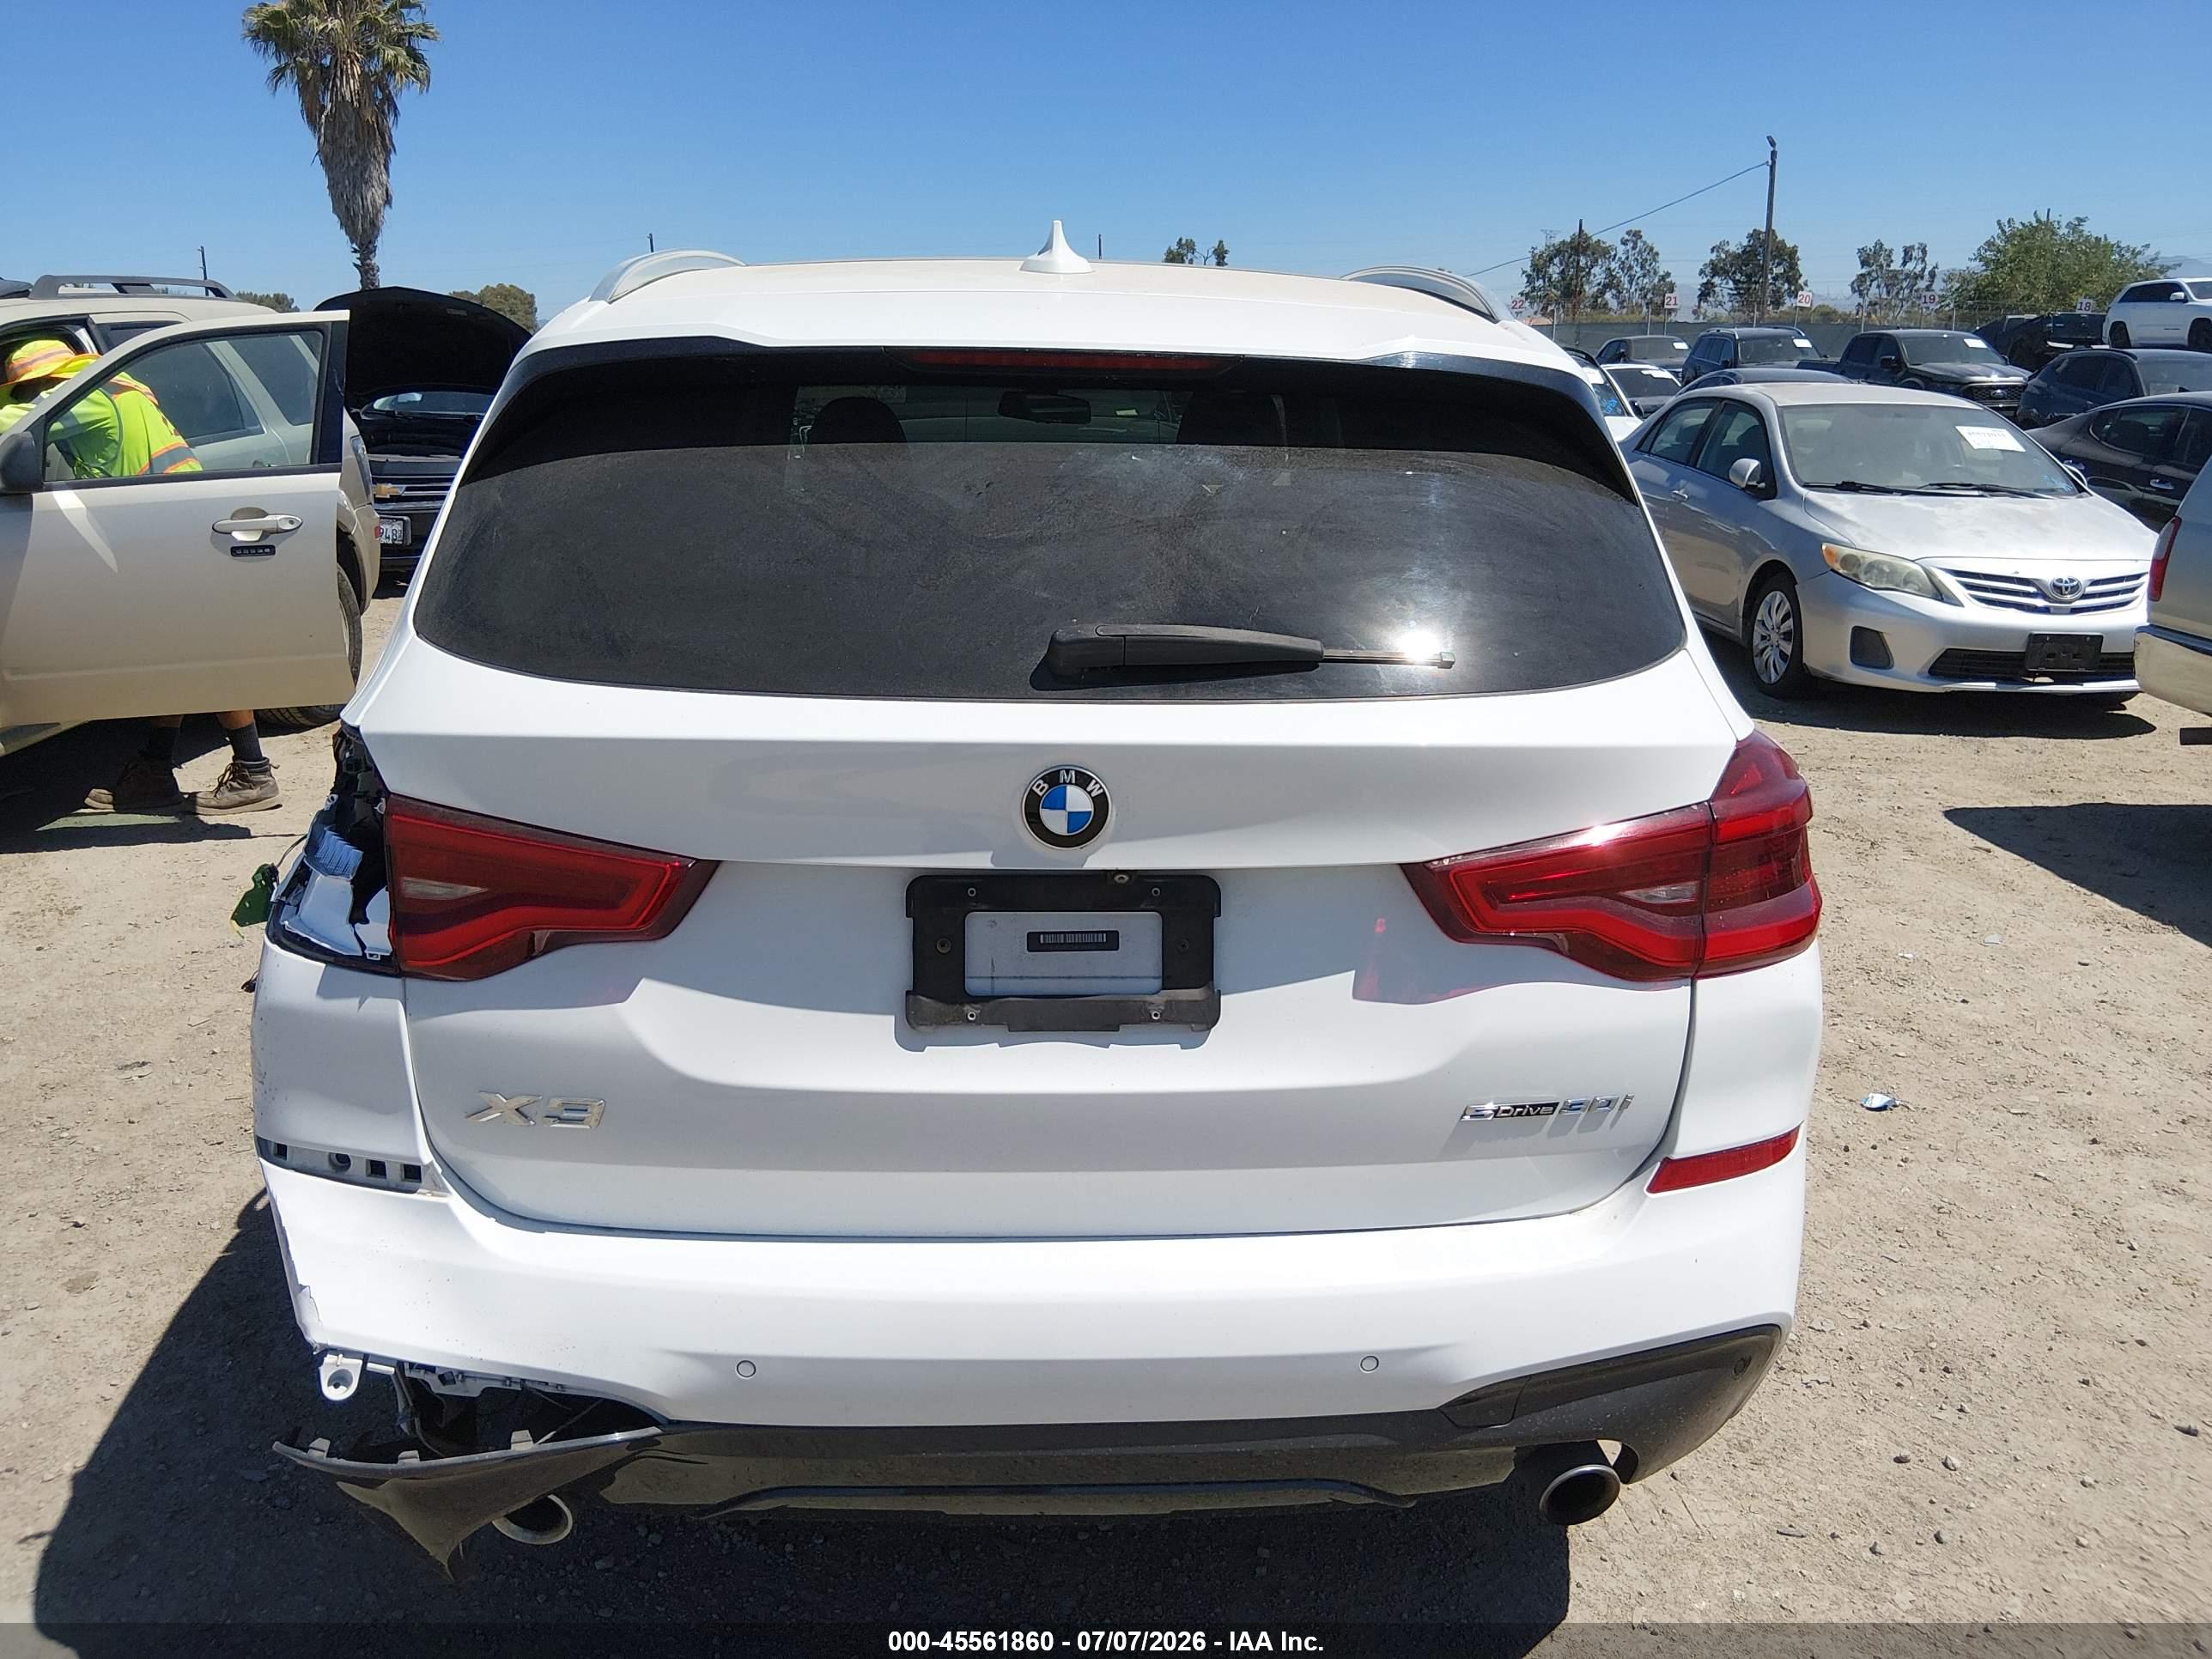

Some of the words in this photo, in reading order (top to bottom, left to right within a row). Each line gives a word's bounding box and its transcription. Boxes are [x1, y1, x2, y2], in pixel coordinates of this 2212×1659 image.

[1665, 296, 1678, 307] 21
[1798, 294, 1811, 304] 20
[1922, 294, 1936, 304] 19
[1511, 300, 1525, 310] 22
[2077, 301, 2092, 312] 18
[1031, 769, 1104, 798] BMW
[465, 1091, 605, 1129] X3
